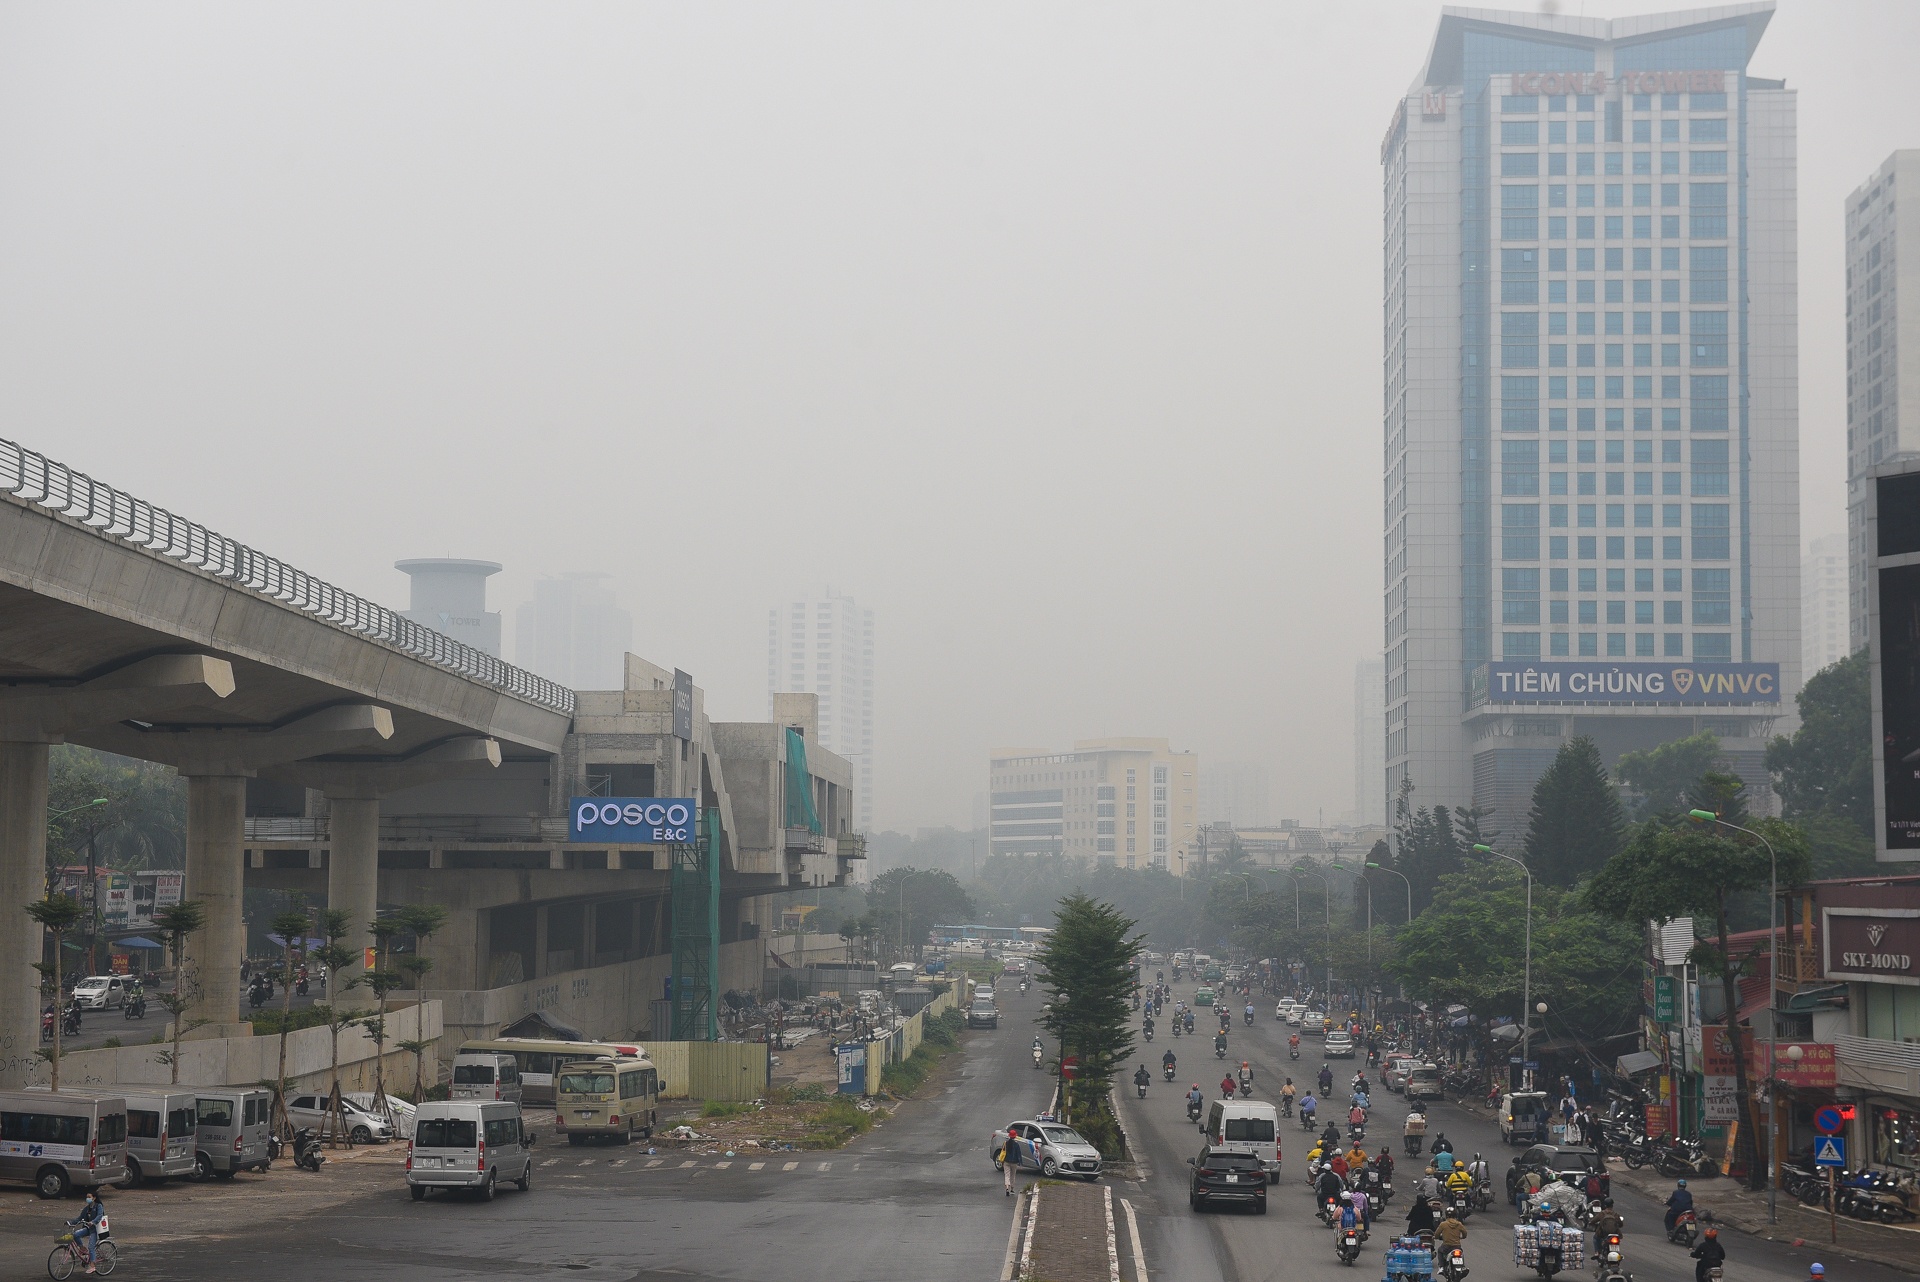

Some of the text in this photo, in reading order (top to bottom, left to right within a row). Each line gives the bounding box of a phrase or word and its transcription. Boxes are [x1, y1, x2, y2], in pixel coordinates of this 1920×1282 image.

[1511, 69, 1726, 95] ICON 4 TOWER
[451, 617, 480, 626] TOWER
[1496, 667, 1774, 694] TIÊM CHỦNG VNVC
[652, 828, 687, 841] E&C
[1842, 951, 1911, 970] SKY-MOND
